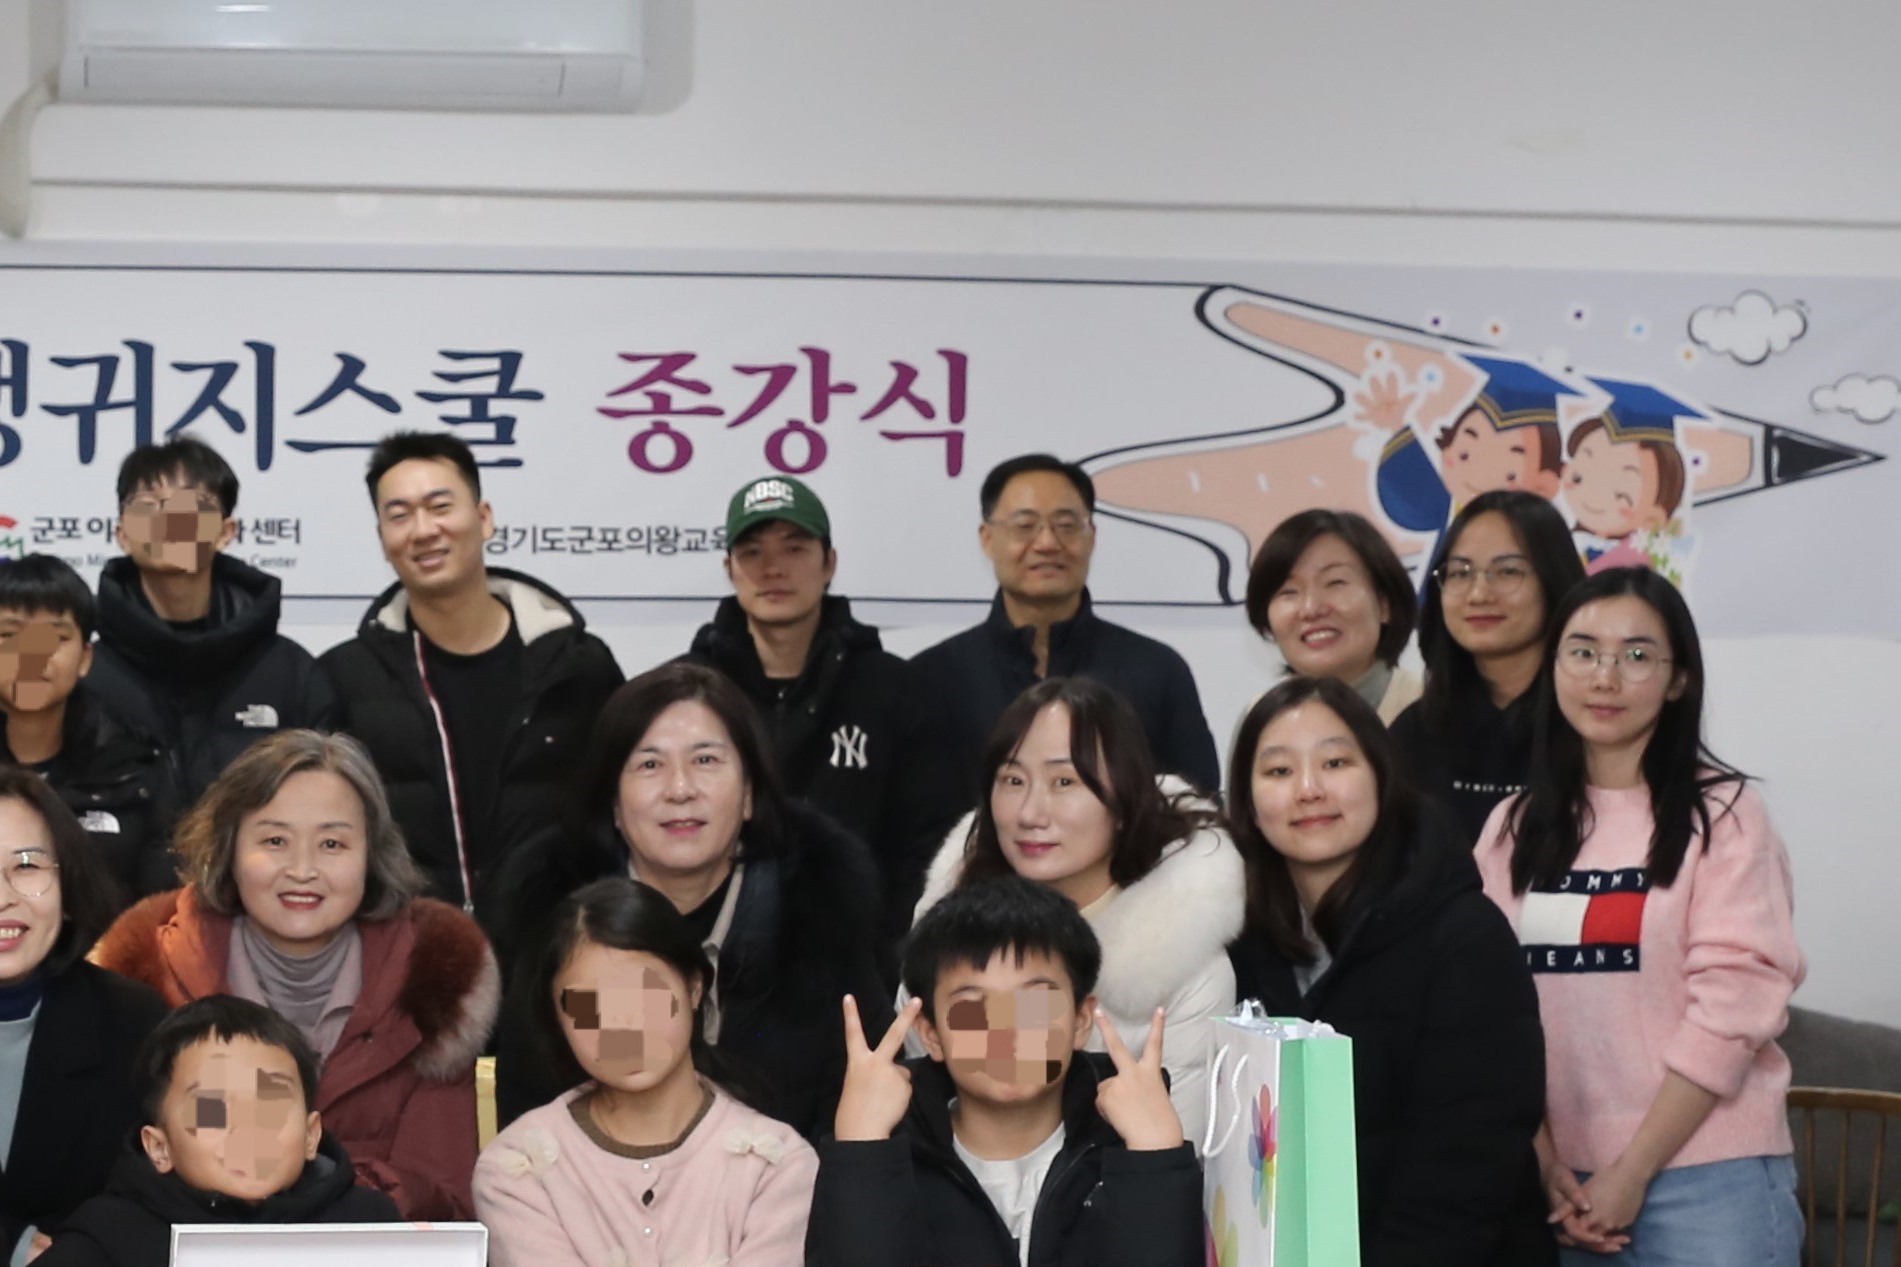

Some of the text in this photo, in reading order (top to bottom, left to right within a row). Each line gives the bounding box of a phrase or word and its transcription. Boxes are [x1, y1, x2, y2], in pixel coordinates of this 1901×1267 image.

[596, 345, 969, 478] 종강식
[30, 516, 82, 544] 군포
[251, 518, 301, 545] 센터
[829, 725, 868, 769] NY
[1560, 872, 1644, 890] OMMY
